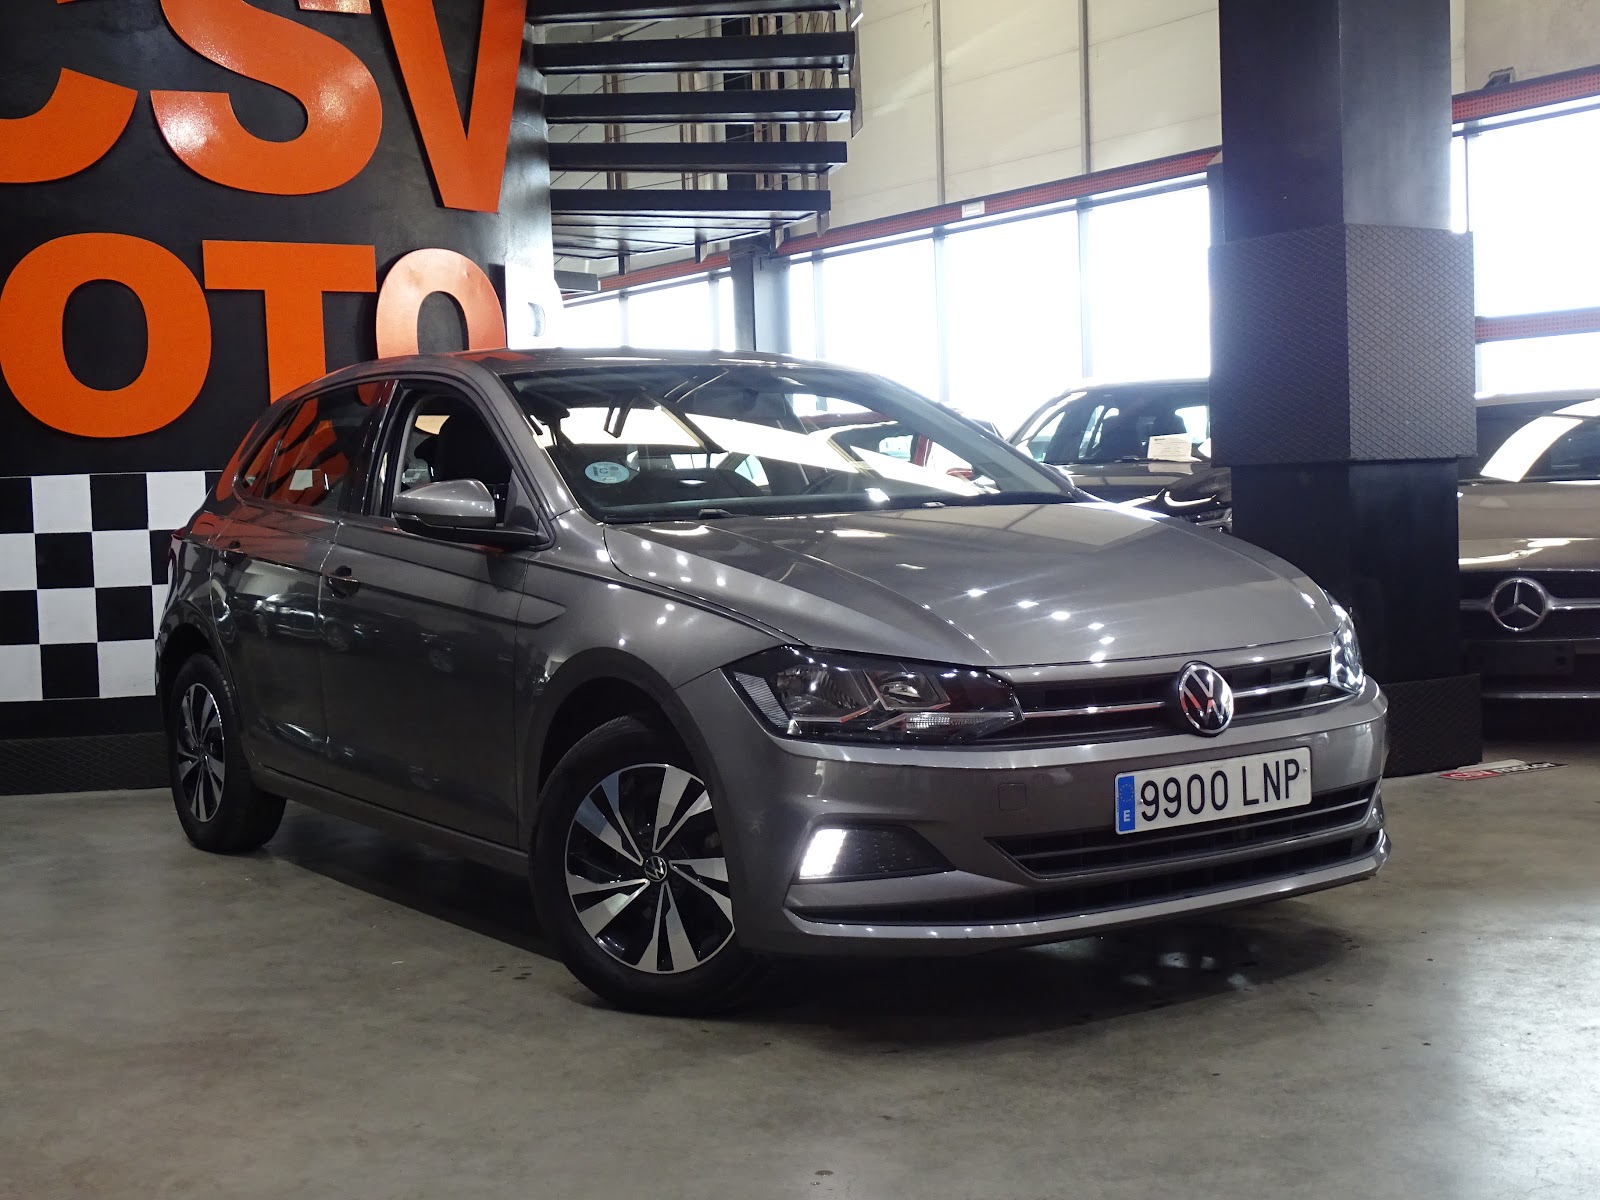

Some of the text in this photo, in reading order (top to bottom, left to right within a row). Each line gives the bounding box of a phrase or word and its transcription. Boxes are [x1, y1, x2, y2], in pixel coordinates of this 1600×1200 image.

[1140, 758, 1300, 821] 9900 LNP
[1123, 809, 1131, 822] E
